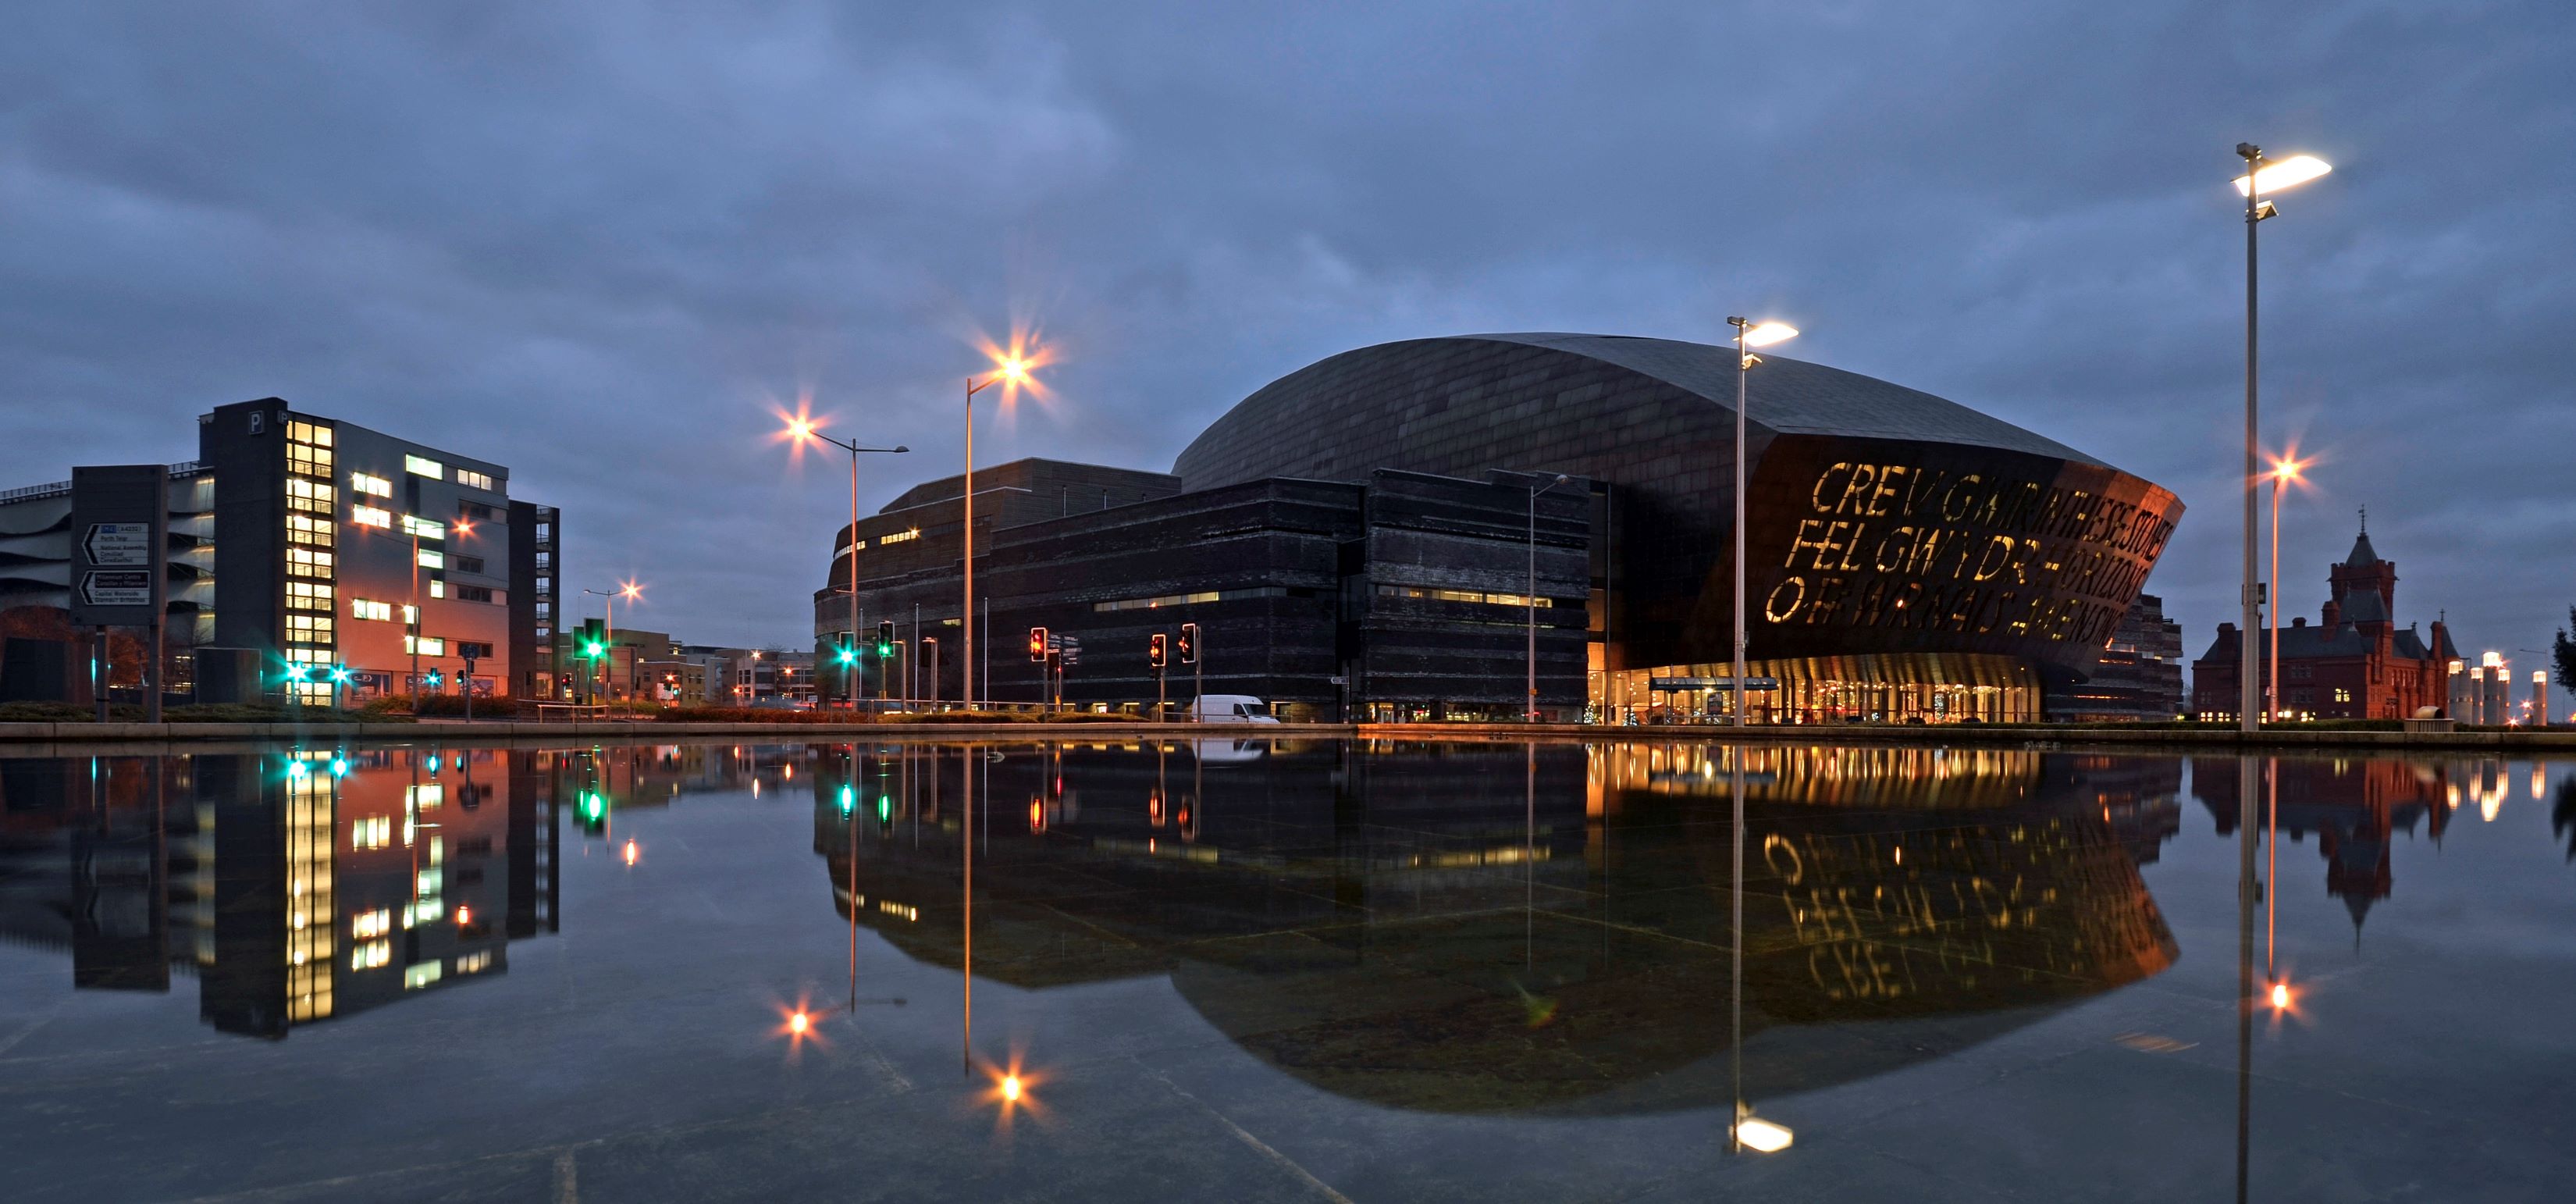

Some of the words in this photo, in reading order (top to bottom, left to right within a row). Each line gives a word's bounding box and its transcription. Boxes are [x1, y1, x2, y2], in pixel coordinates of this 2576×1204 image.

[251, 413, 261, 433] P
[1784, 518, 1864, 572] FEL
[1876, 526, 2041, 585] GWYDR
[1765, 575, 1806, 624] O
